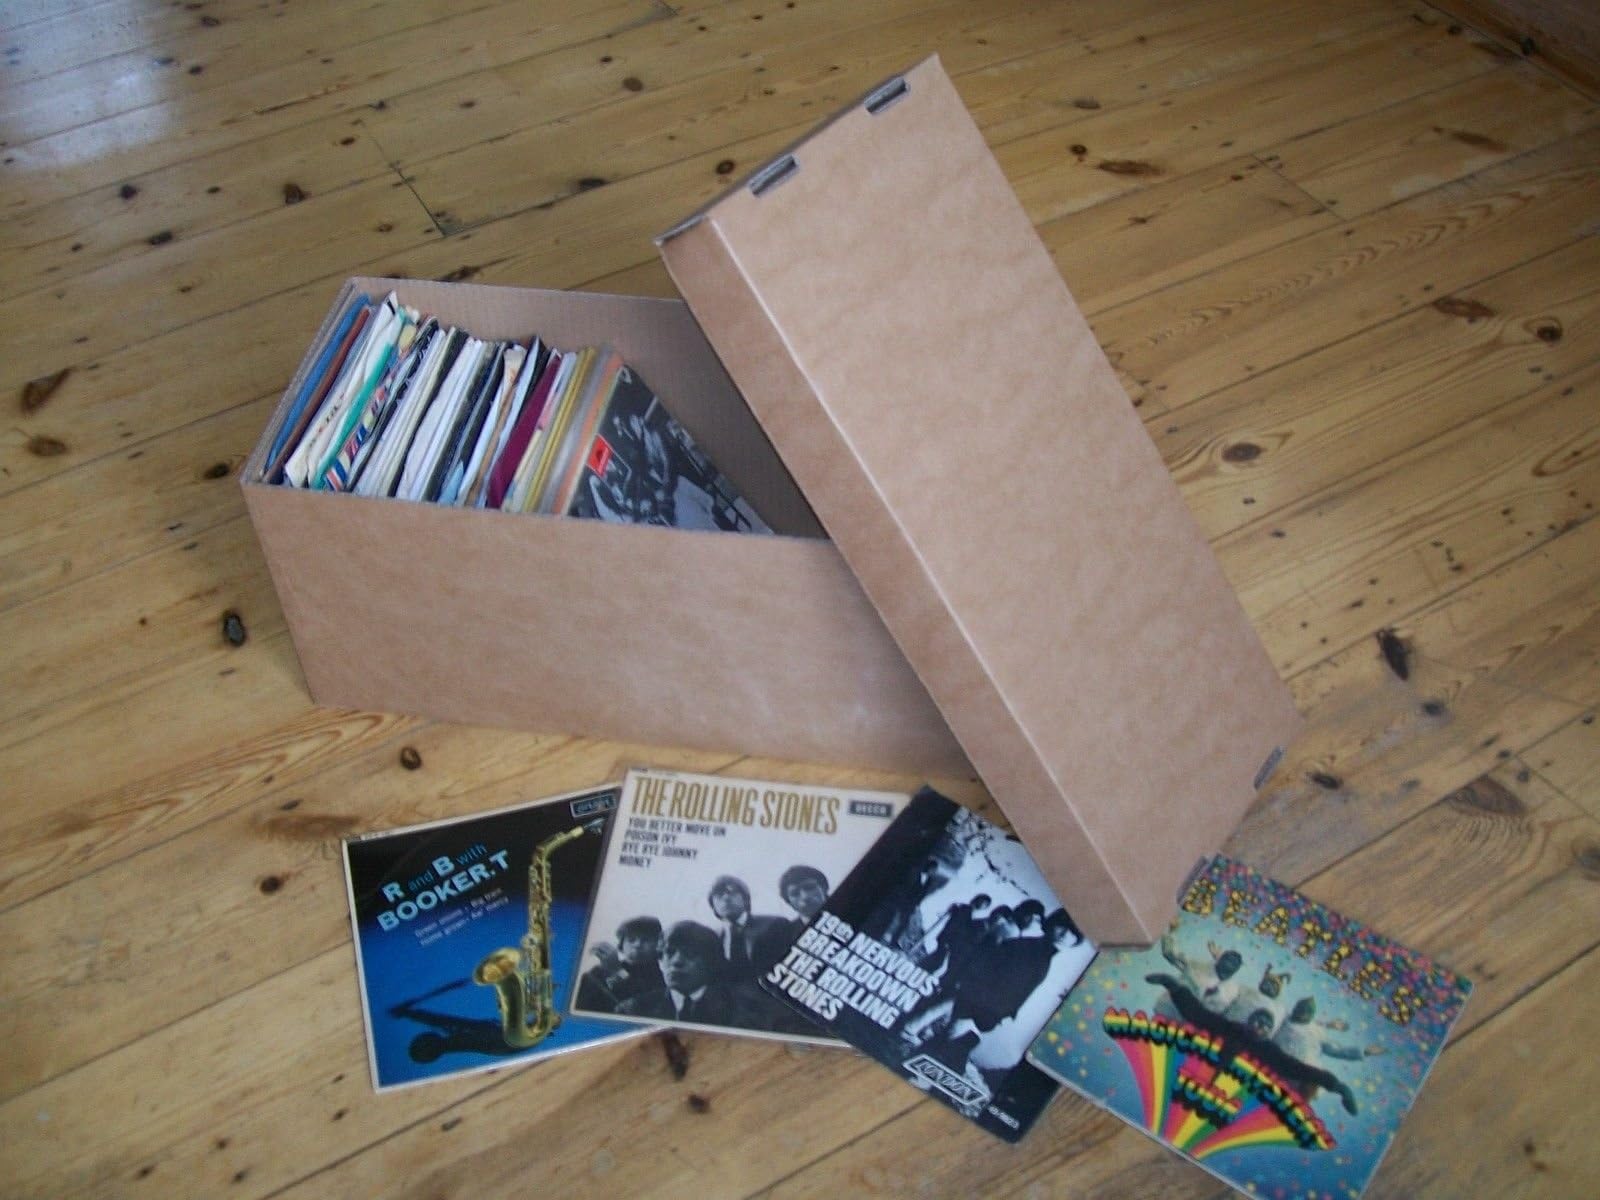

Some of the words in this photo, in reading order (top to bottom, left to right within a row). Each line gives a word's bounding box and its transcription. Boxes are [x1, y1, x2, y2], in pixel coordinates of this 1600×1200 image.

[628, 817, 647, 830] YOU
[685, 823, 711, 837] MOVE
[630, 776, 673, 818] THE
[669, 780, 758, 827] ROLLING
[760, 789, 840, 835] STONES
[382, 880, 405, 903] R
[408, 869, 434, 892] and
[431, 855, 455, 877] B
[455, 843, 488, 866] with
[766, 963, 844, 1021] STONES
[784, 946, 824, 981] THE
[816, 966, 899, 1030] ROLLING
[796, 928, 922, 1012] BREAKDOWN
[849, 932, 940, 997] NERVOUS
